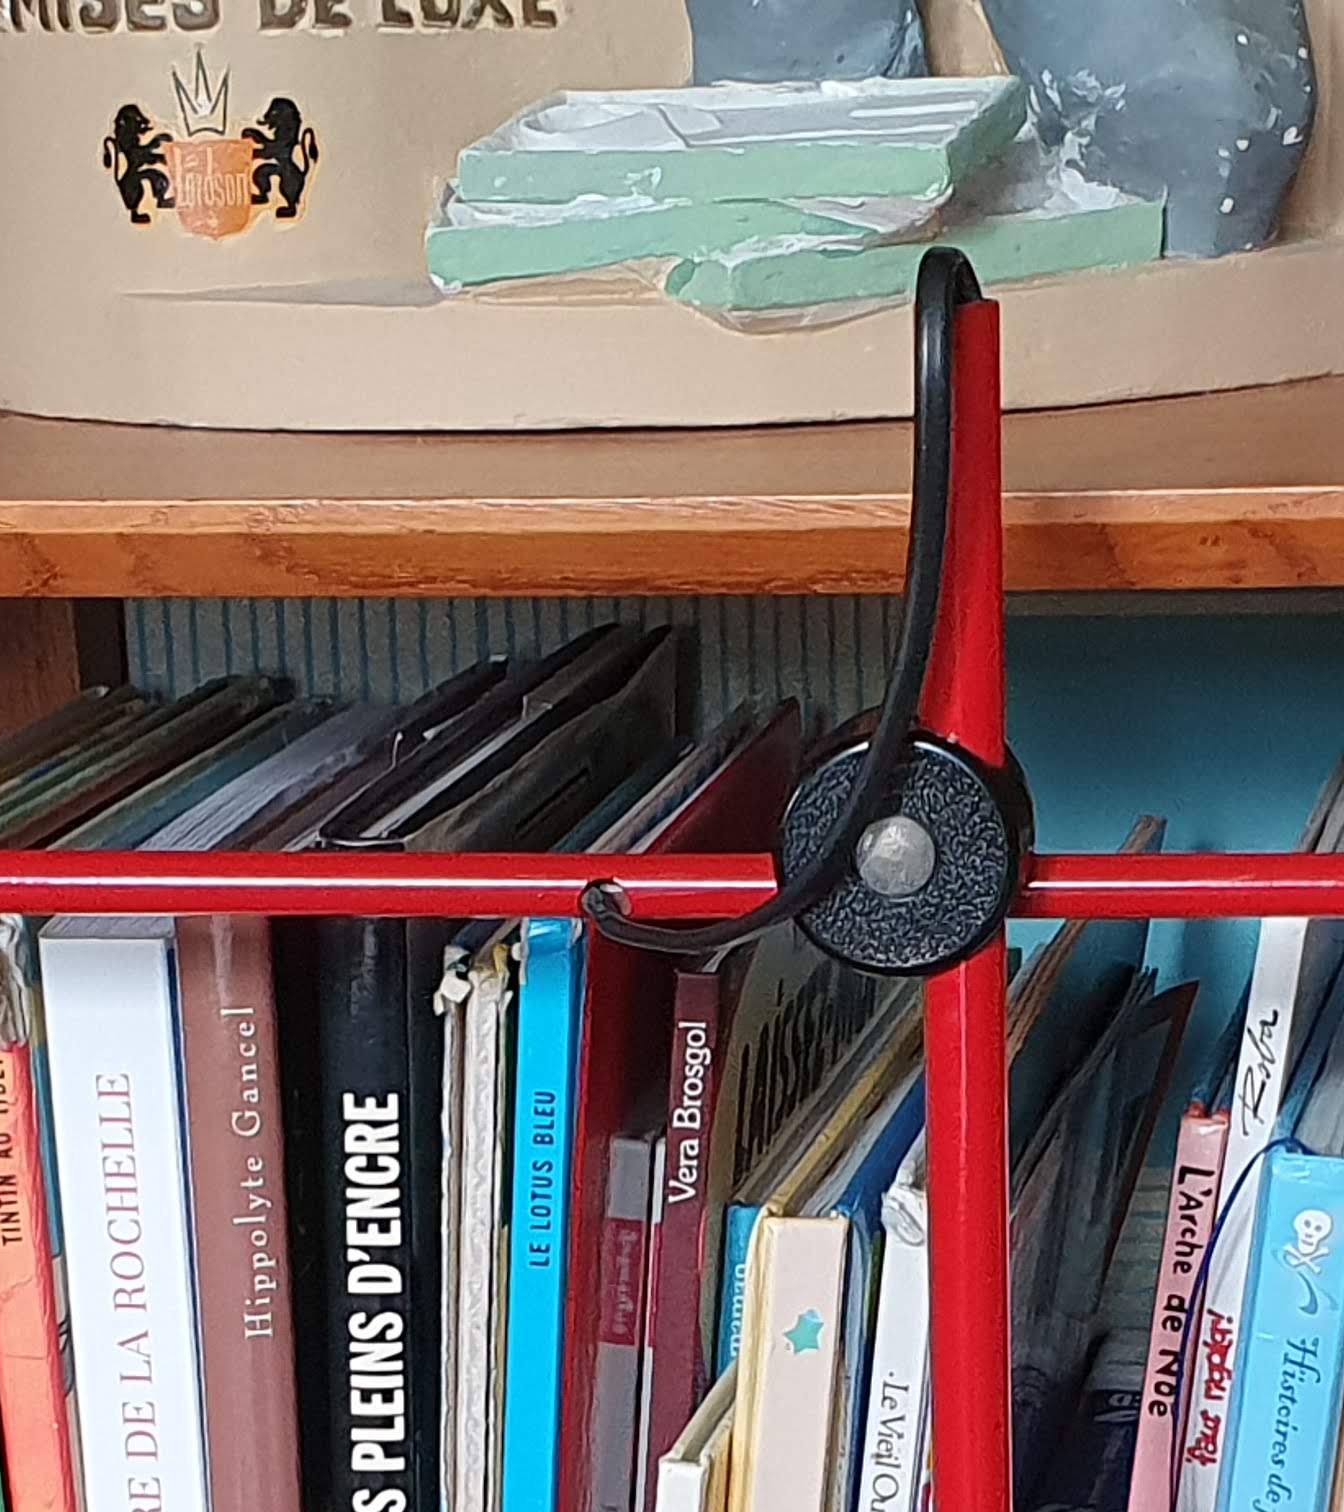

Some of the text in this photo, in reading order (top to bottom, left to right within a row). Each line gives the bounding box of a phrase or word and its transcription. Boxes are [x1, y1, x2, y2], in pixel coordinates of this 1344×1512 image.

[95, 1070, 148, 1309] ROCHELLE
[218, 1005, 280, 1338] Hippolyte Gancel
[528, 1090, 556, 1266] LE LOTUS BLEU
[668, 1019, 713, 1204] Vera Brosgol
[343, 1094, 402, 1296] D'ENCRE
[1165, 1164, 1215, 1278] L'Arche
[114, 1327, 153, 1385] LA
[347, 1312, 406, 1471] PLEINS
[1160, 1292, 1191, 1334] de
[119, 1396, 159, 1461] DE
[1266, 1332, 1326, 1470] Histoires
